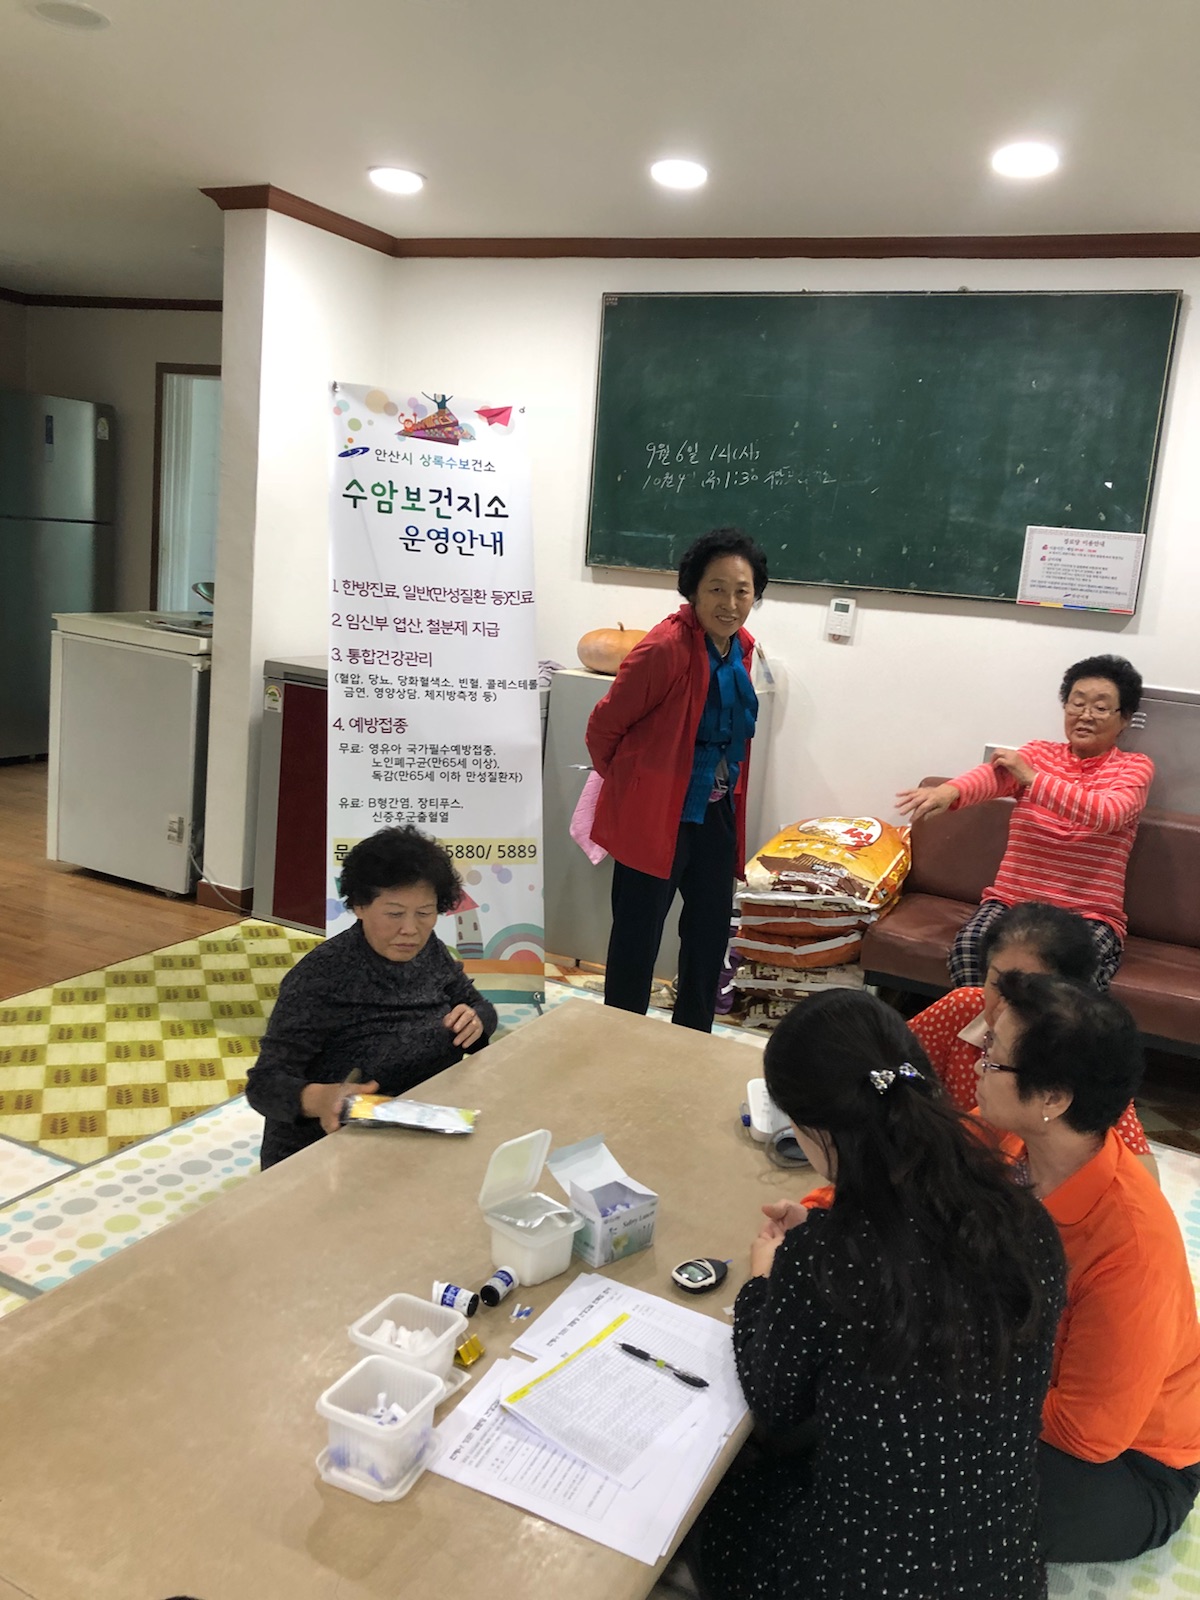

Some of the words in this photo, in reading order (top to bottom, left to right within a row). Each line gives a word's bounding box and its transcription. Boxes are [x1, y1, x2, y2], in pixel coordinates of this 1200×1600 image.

[375, 449, 413, 465] 안산시
[419, 454, 496, 472] 상록수보건소
[342, 479, 509, 519] 수암보건지소
[399, 525, 504, 556] 운영안내
[402, 585, 487, 604] 일반(만성질환
[490, 590, 535, 606] 등)진료
[346, 613, 389, 631] 임신부
[426, 618, 468, 636] 철분제
[472, 621, 500, 638] 지급
[331, 647, 343, 662] 3.
[346, 648, 432, 668] 통합건강관리
[424, 689, 477, 702] 체지방측정
[482, 691, 497, 703] 등)
[332, 717, 345, 732] 4.
[348, 717, 408, 734] 예방접종
[339, 742, 364, 754] 무료:
[369, 743, 402, 755] 영유아
[371, 757, 467, 769] 노인폐구균(만65세
[371, 770, 435, 782] 독감(만65세
[440, 771, 461, 783] 이하
[466, 771, 523, 783] 만성질환자)
[338, 797, 364, 809] 유료:
[372, 811, 449, 823] 신증후군출혈열
[497, 844, 537, 859] 5889
